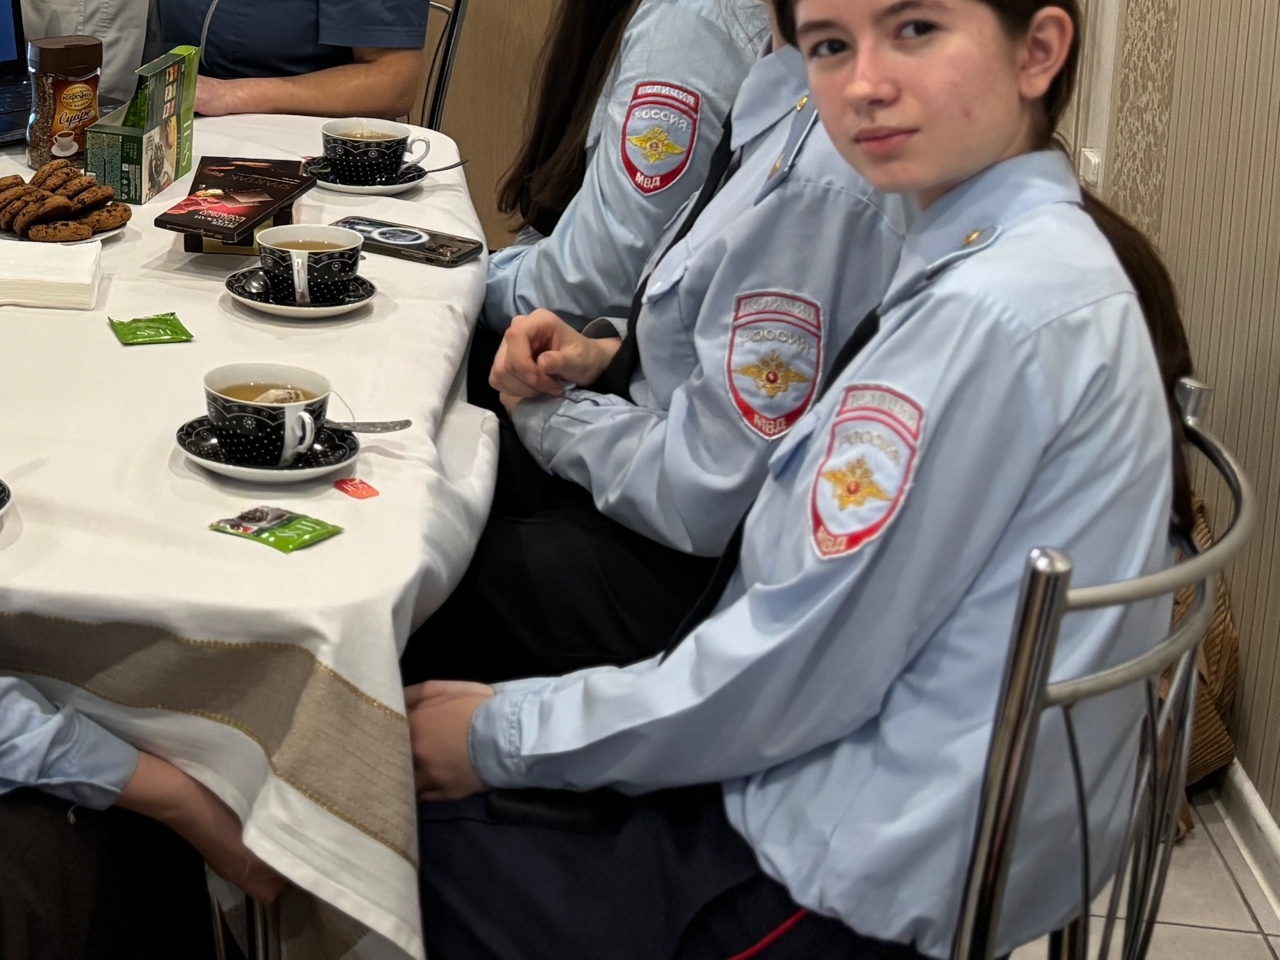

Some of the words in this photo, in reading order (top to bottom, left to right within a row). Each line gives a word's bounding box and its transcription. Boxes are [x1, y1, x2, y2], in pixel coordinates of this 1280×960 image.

[637, 85, 695, 107] ПОЛИЦИЯ
[634, 109, 689, 132] РОССИЯ
[636, 171, 661, 189] МВД
[740, 328, 812, 355] РОССИЯ
[754, 413, 787, 435] МВД
